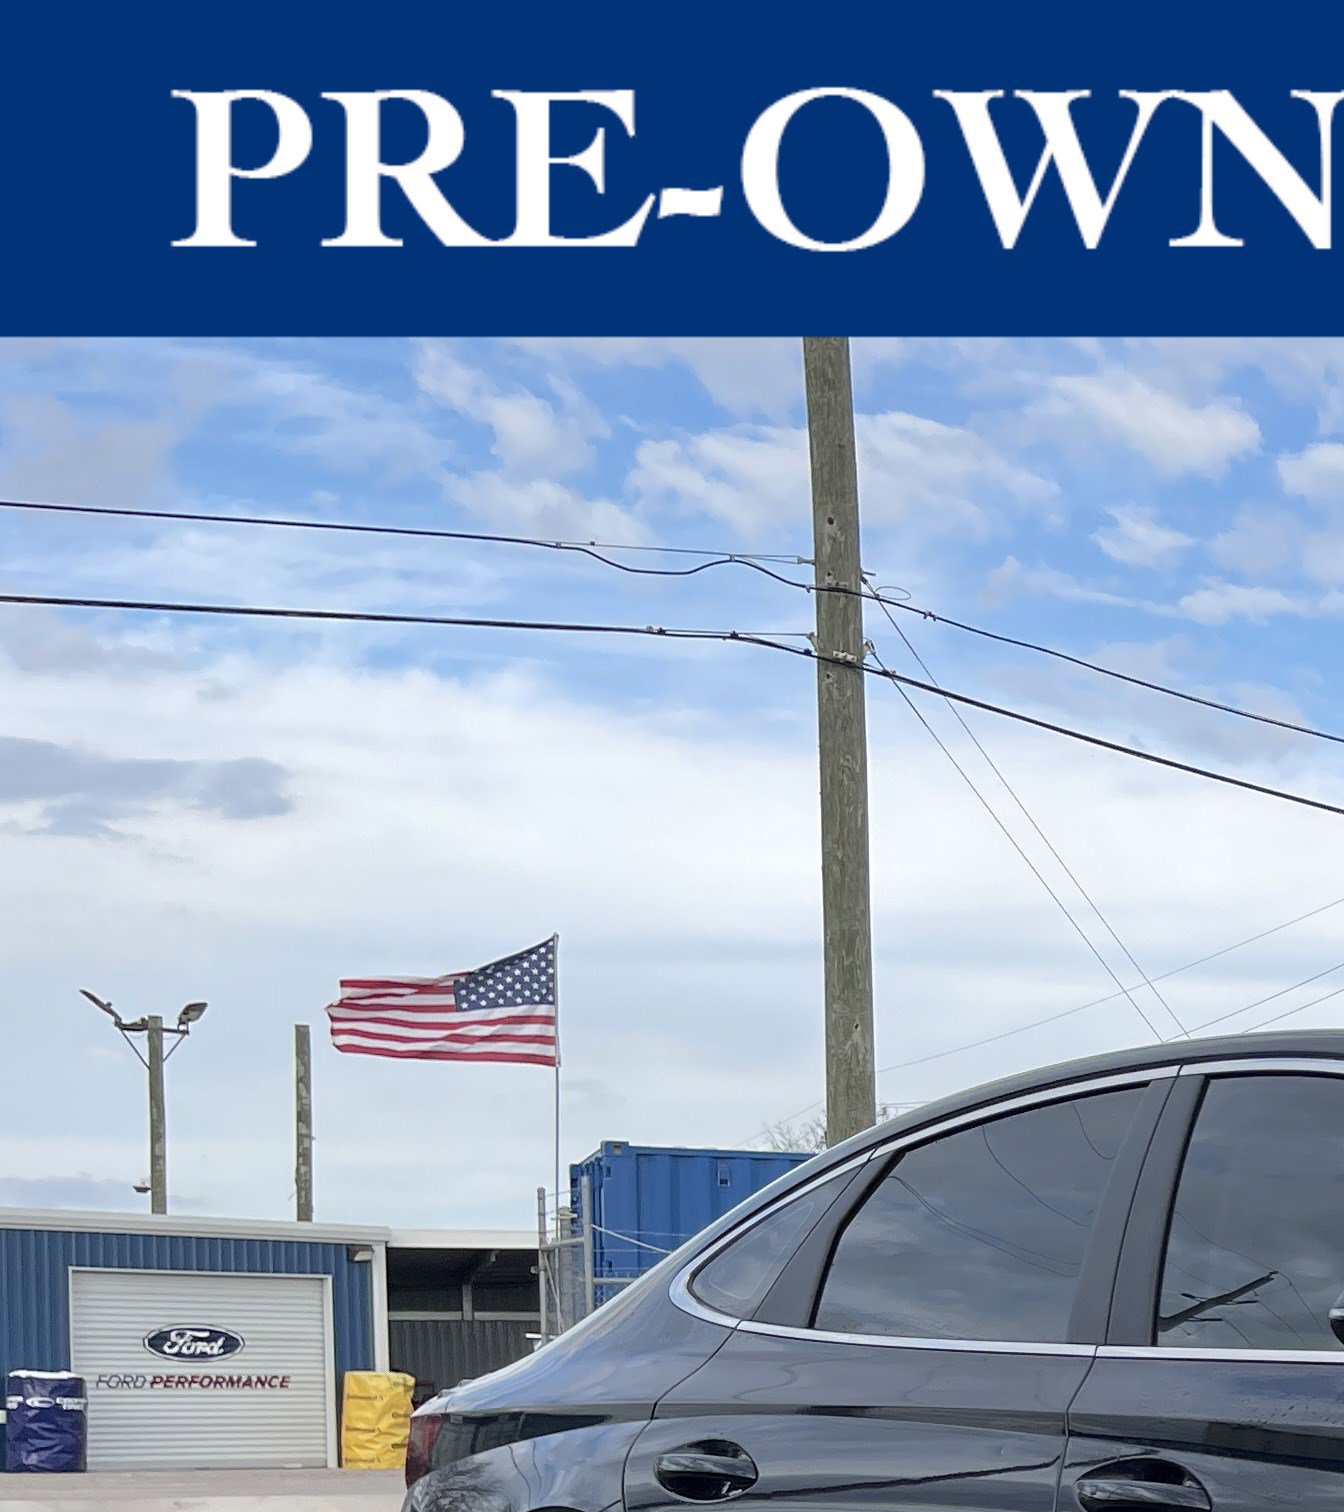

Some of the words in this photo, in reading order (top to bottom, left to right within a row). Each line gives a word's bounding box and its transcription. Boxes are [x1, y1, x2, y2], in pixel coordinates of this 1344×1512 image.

[161, 1329, 226, 1355] Ford
[96, 1374, 147, 1389] FORD
[150, 1374, 291, 1389] PERFORMANCE
